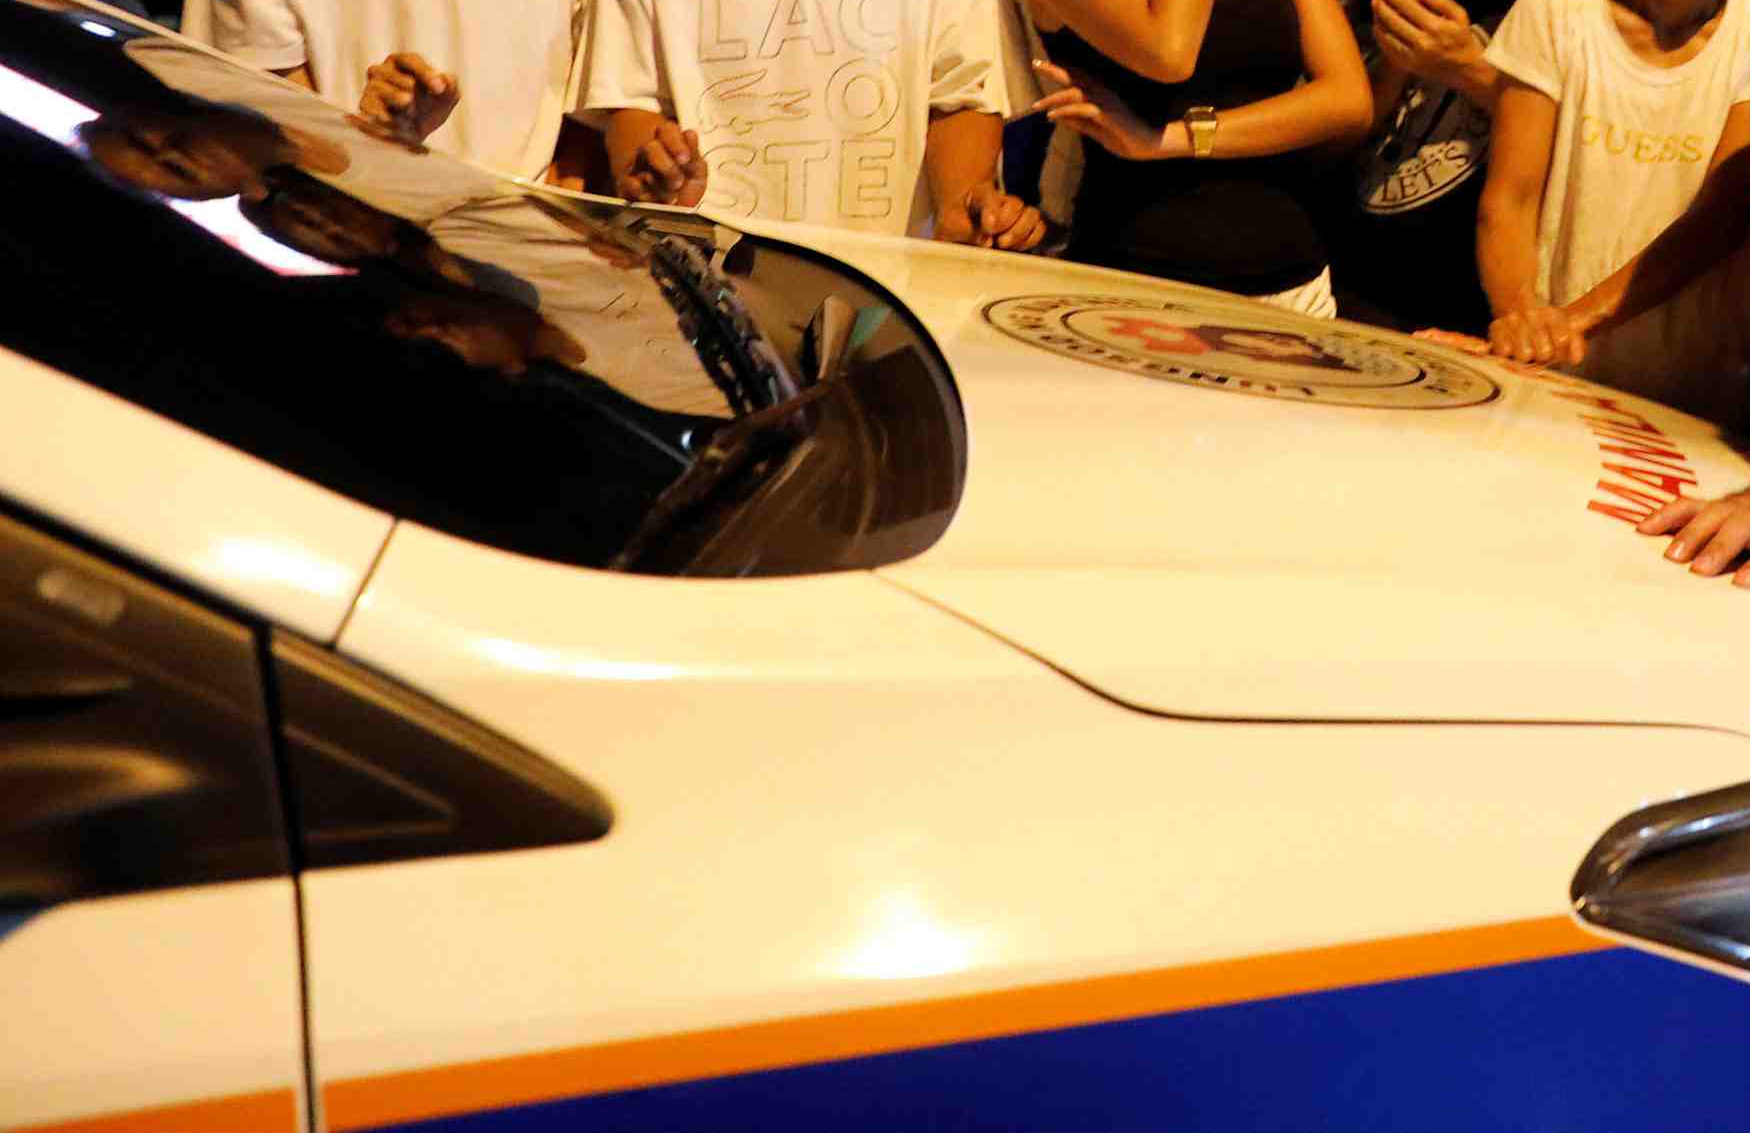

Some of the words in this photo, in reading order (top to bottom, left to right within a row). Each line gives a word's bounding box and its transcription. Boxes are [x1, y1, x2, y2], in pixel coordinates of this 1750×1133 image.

[824, 58, 901, 136] O
[700, 138, 896, 221] STE
[1381, 146, 1471, 202] LET'S
